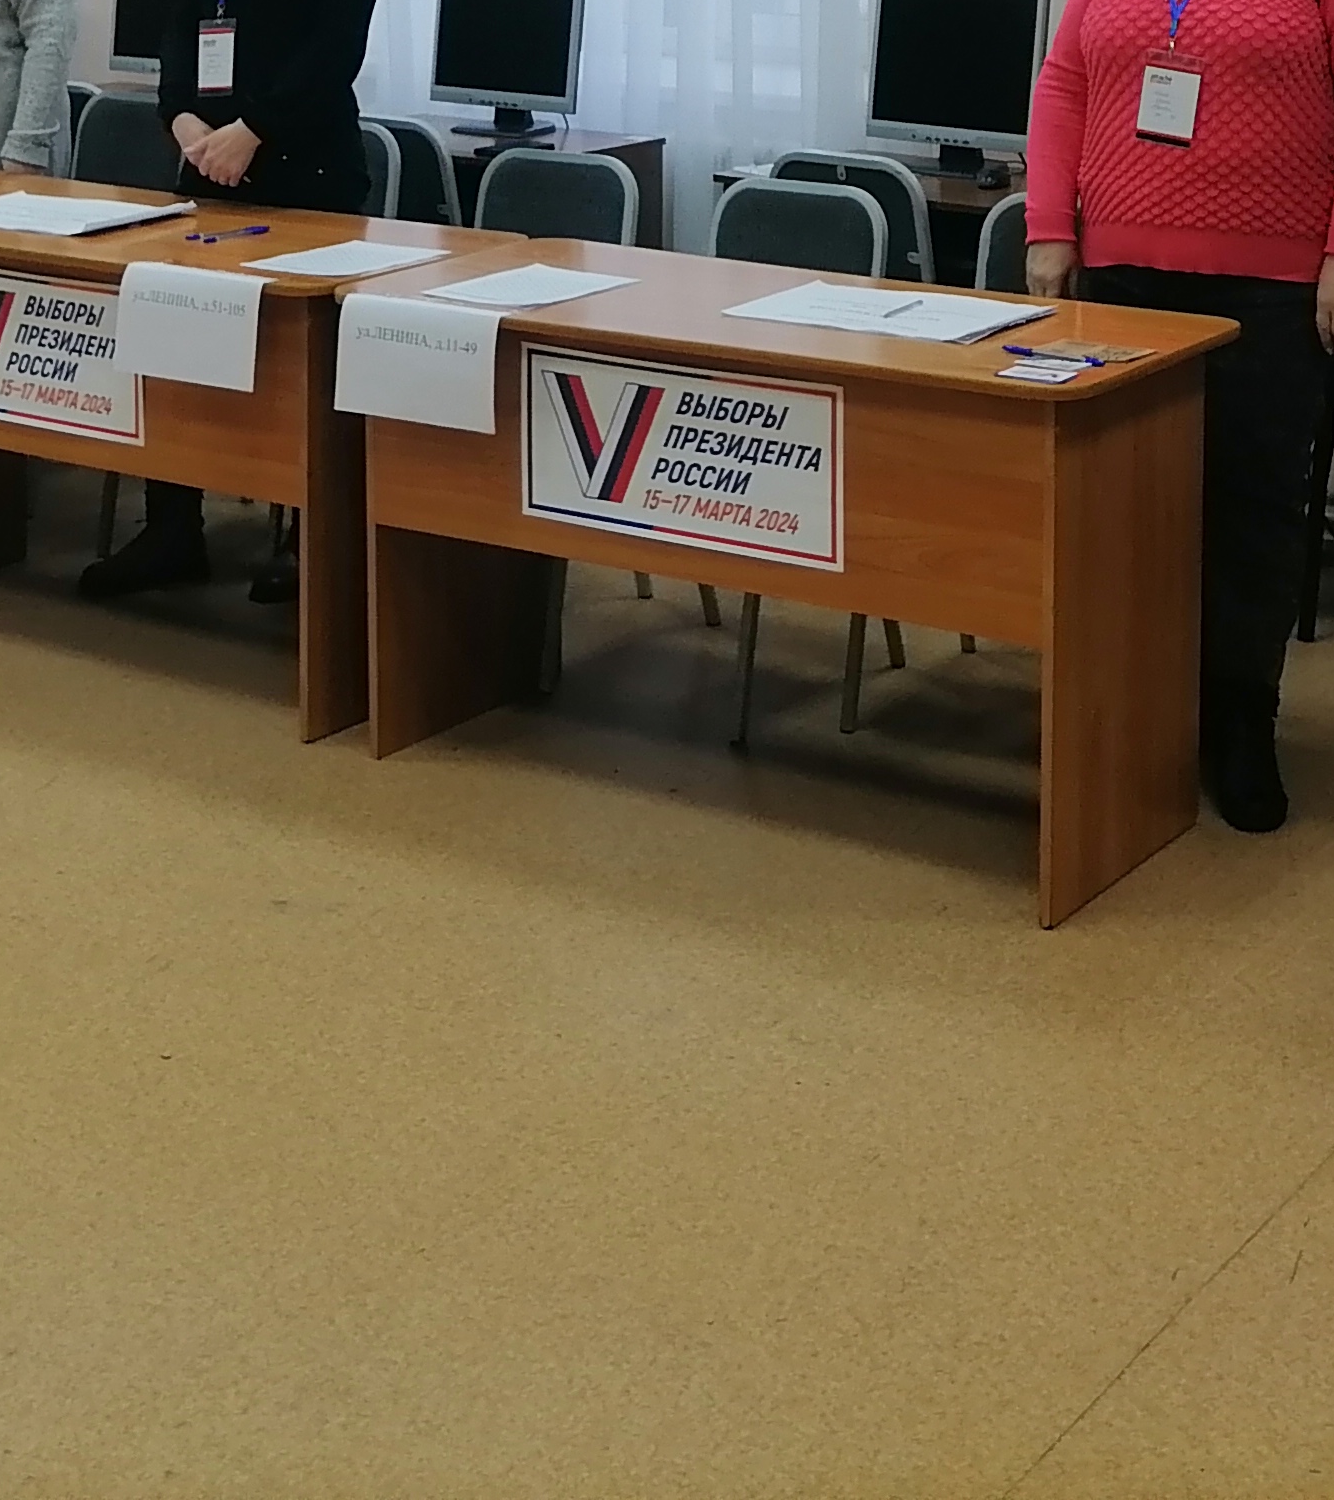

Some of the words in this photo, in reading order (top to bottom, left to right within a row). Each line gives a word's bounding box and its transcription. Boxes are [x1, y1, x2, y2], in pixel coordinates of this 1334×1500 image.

[23, 295, 106, 328] ВЫБОРЫ
[14, 324, 117, 360] ПРЕЗИДЕНТ
[5, 352, 80, 383] РОССИИ
[36, 387, 79, 410] МАРТА
[80, 394, 113, 416] 2024
[675, 391, 790, 431] ВЫБОРЫ
[663, 424, 823, 473] ПРЕЗИДЕНТА
[651, 457, 753, 497] РОССИИ
[691, 499, 754, 528] МАРТА
[754, 509, 801, 536] 2024
